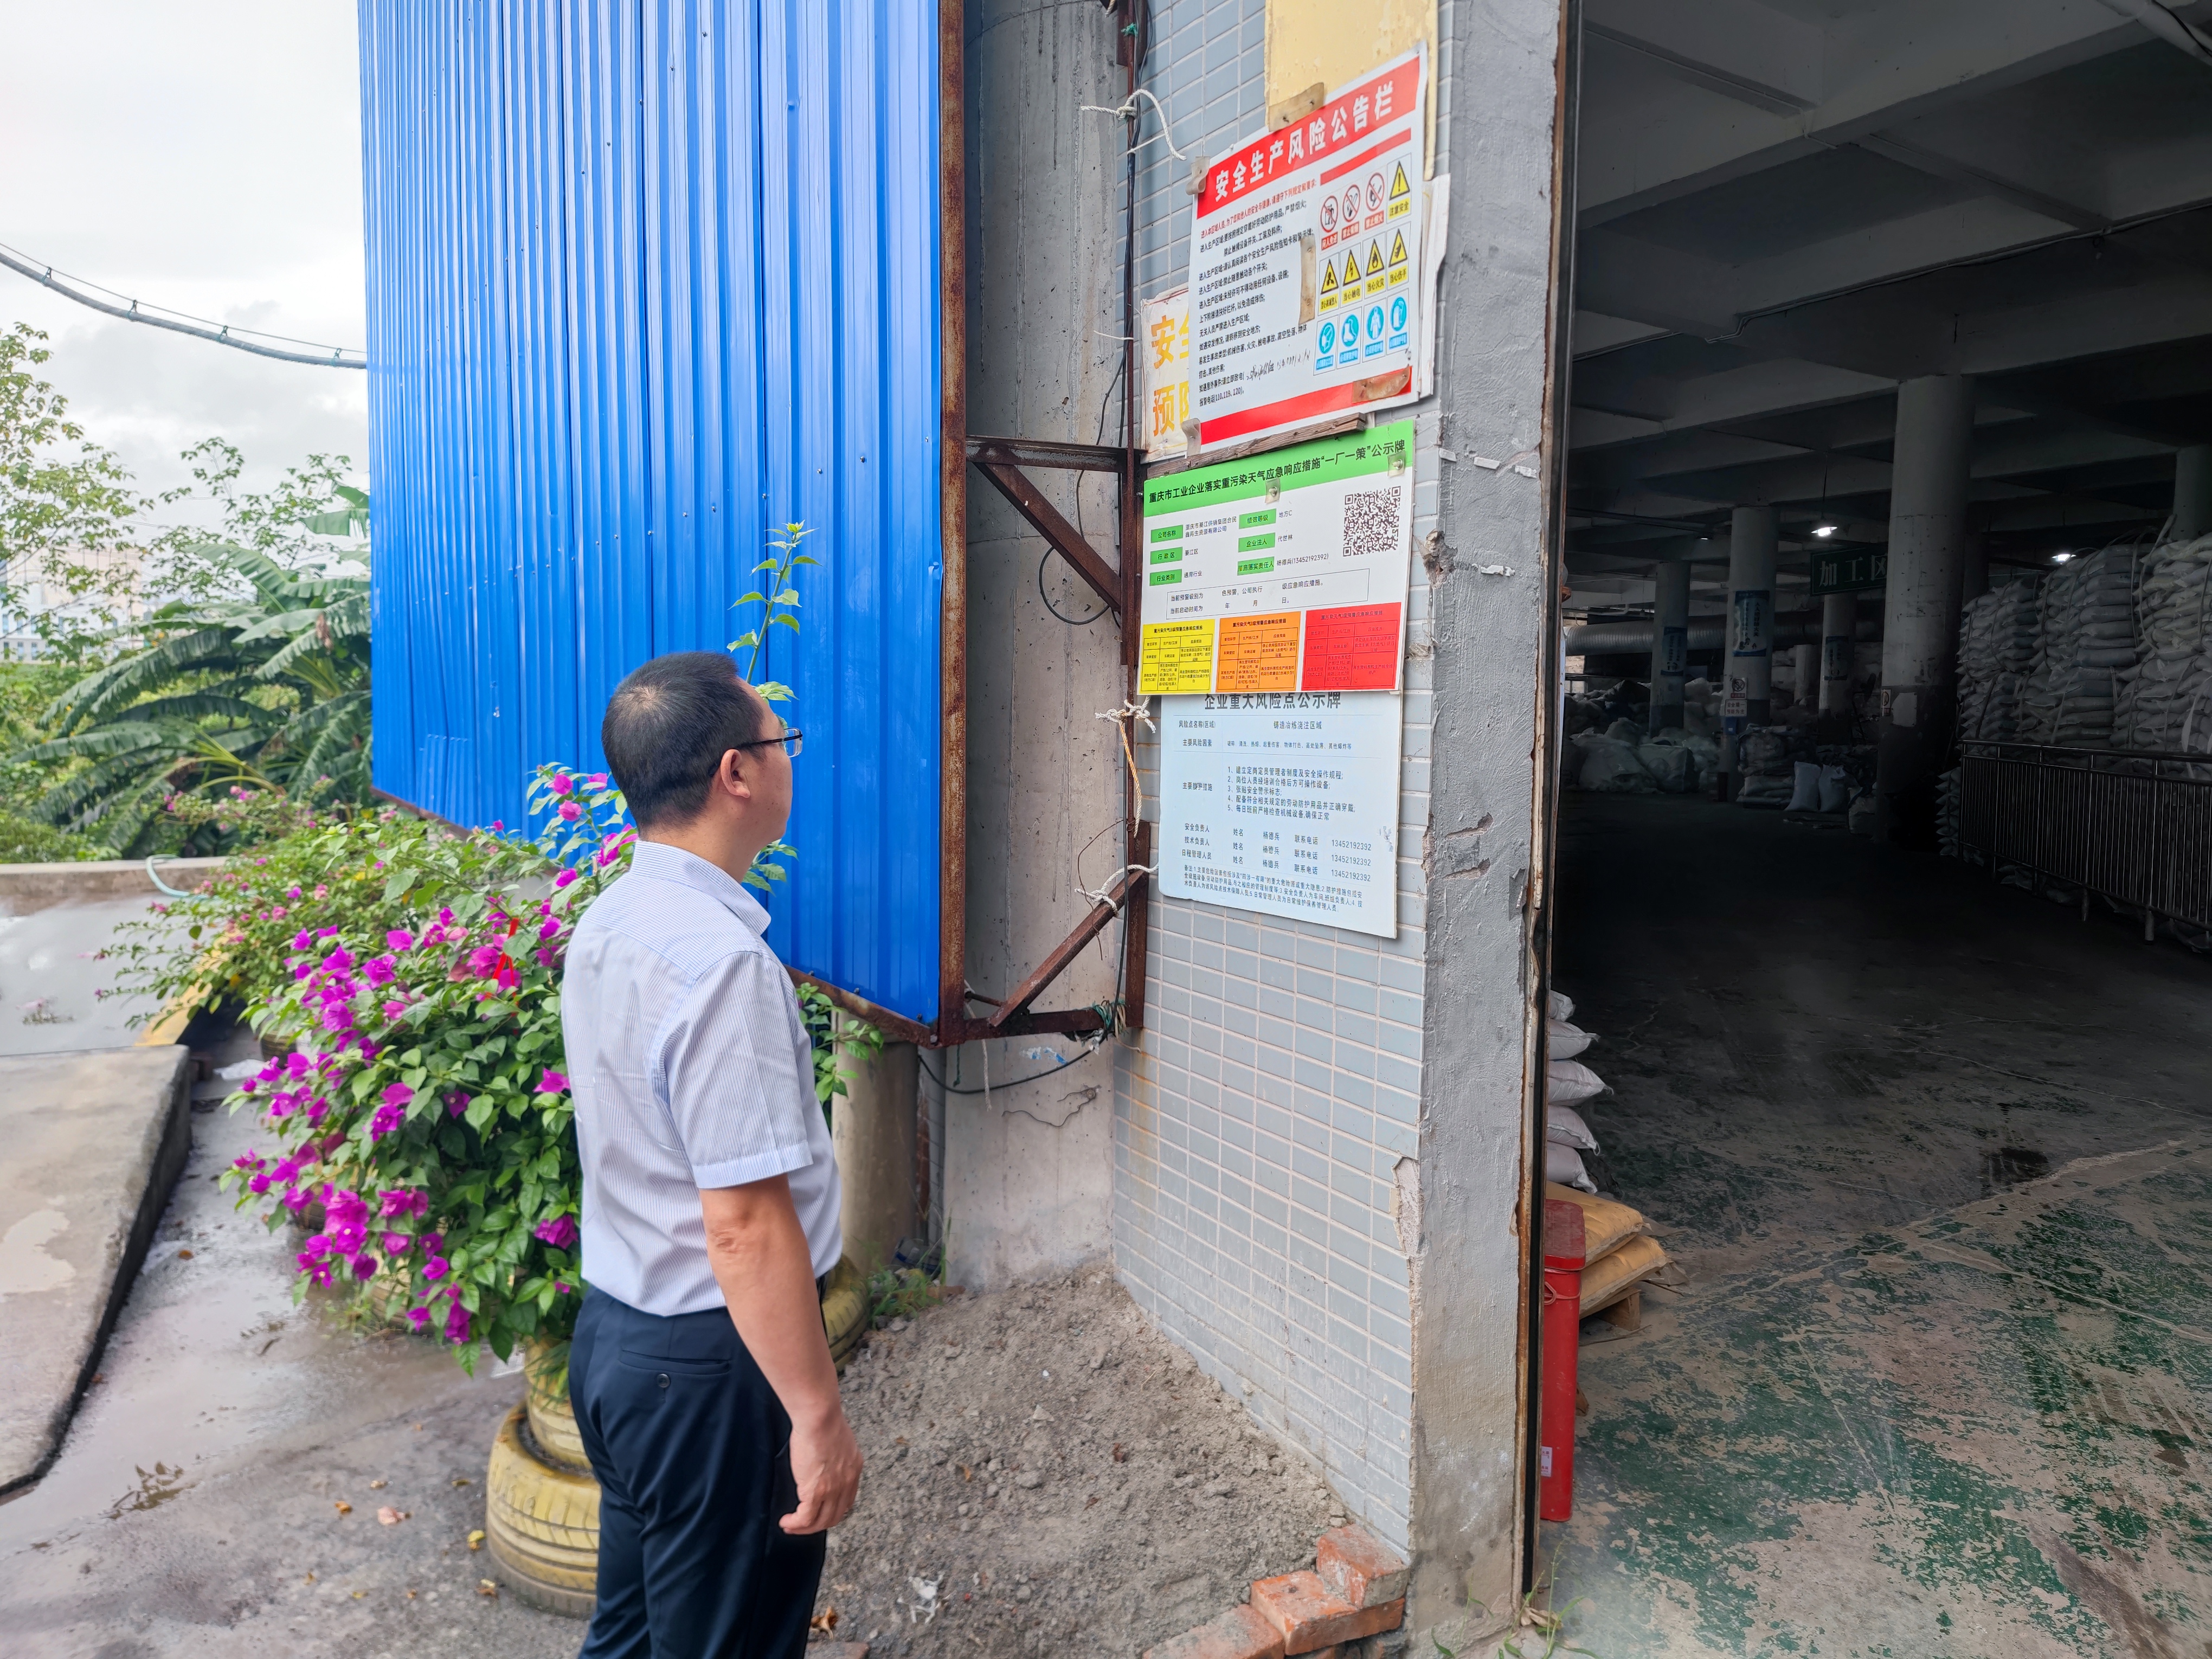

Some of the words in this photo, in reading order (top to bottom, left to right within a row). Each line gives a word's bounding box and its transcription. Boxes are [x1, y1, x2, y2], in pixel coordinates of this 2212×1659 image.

[1215, 80, 1393, 202] 安全生产风险公告栏
[1149, 439, 1405, 503] 重庆市工业企业落实重污染天气应急响应措施“一厂一策”公示牌
[1158, 530, 1176, 538] 公司名称
[1246, 538, 1268, 548] 企业法人
[1818, 552, 1888, 587] 加工区
[1156, 574, 1175, 582] 行业类别
[1171, 592, 1204, 601] 当前预警级别为
[1170, 606, 1203, 614] 当前启动时间为
[1204, 692, 1341, 710] 企业重大风险点公示牌
[1179, 720, 1216, 729] 风险点名称(区域)
[1274, 720, 1322, 730] 铸造冶炼浇注区域
[1182, 738, 1212, 747] 主要风险因素
[1233, 828, 1244, 837] 姓名
[1263, 831, 1280, 841] 杨德兵
[1294, 834, 1319, 846] 联系电话
[1332, 839, 1372, 851] 13452192392
[1185, 837, 1210, 846] 技术负责人
[1232, 842, 1244, 851] 姓名
[1263, 845, 1279, 855] 杨德兵
[1294, 849, 1318, 861] 联系电话
[1331, 854, 1372, 866] 13452192392
[1232, 856, 1244, 865] 姓名
[1262, 859, 1279, 870] 杨德兵
[1294, 864, 1318, 876] 联系电话
[1331, 869, 1372, 882] 13452192392
